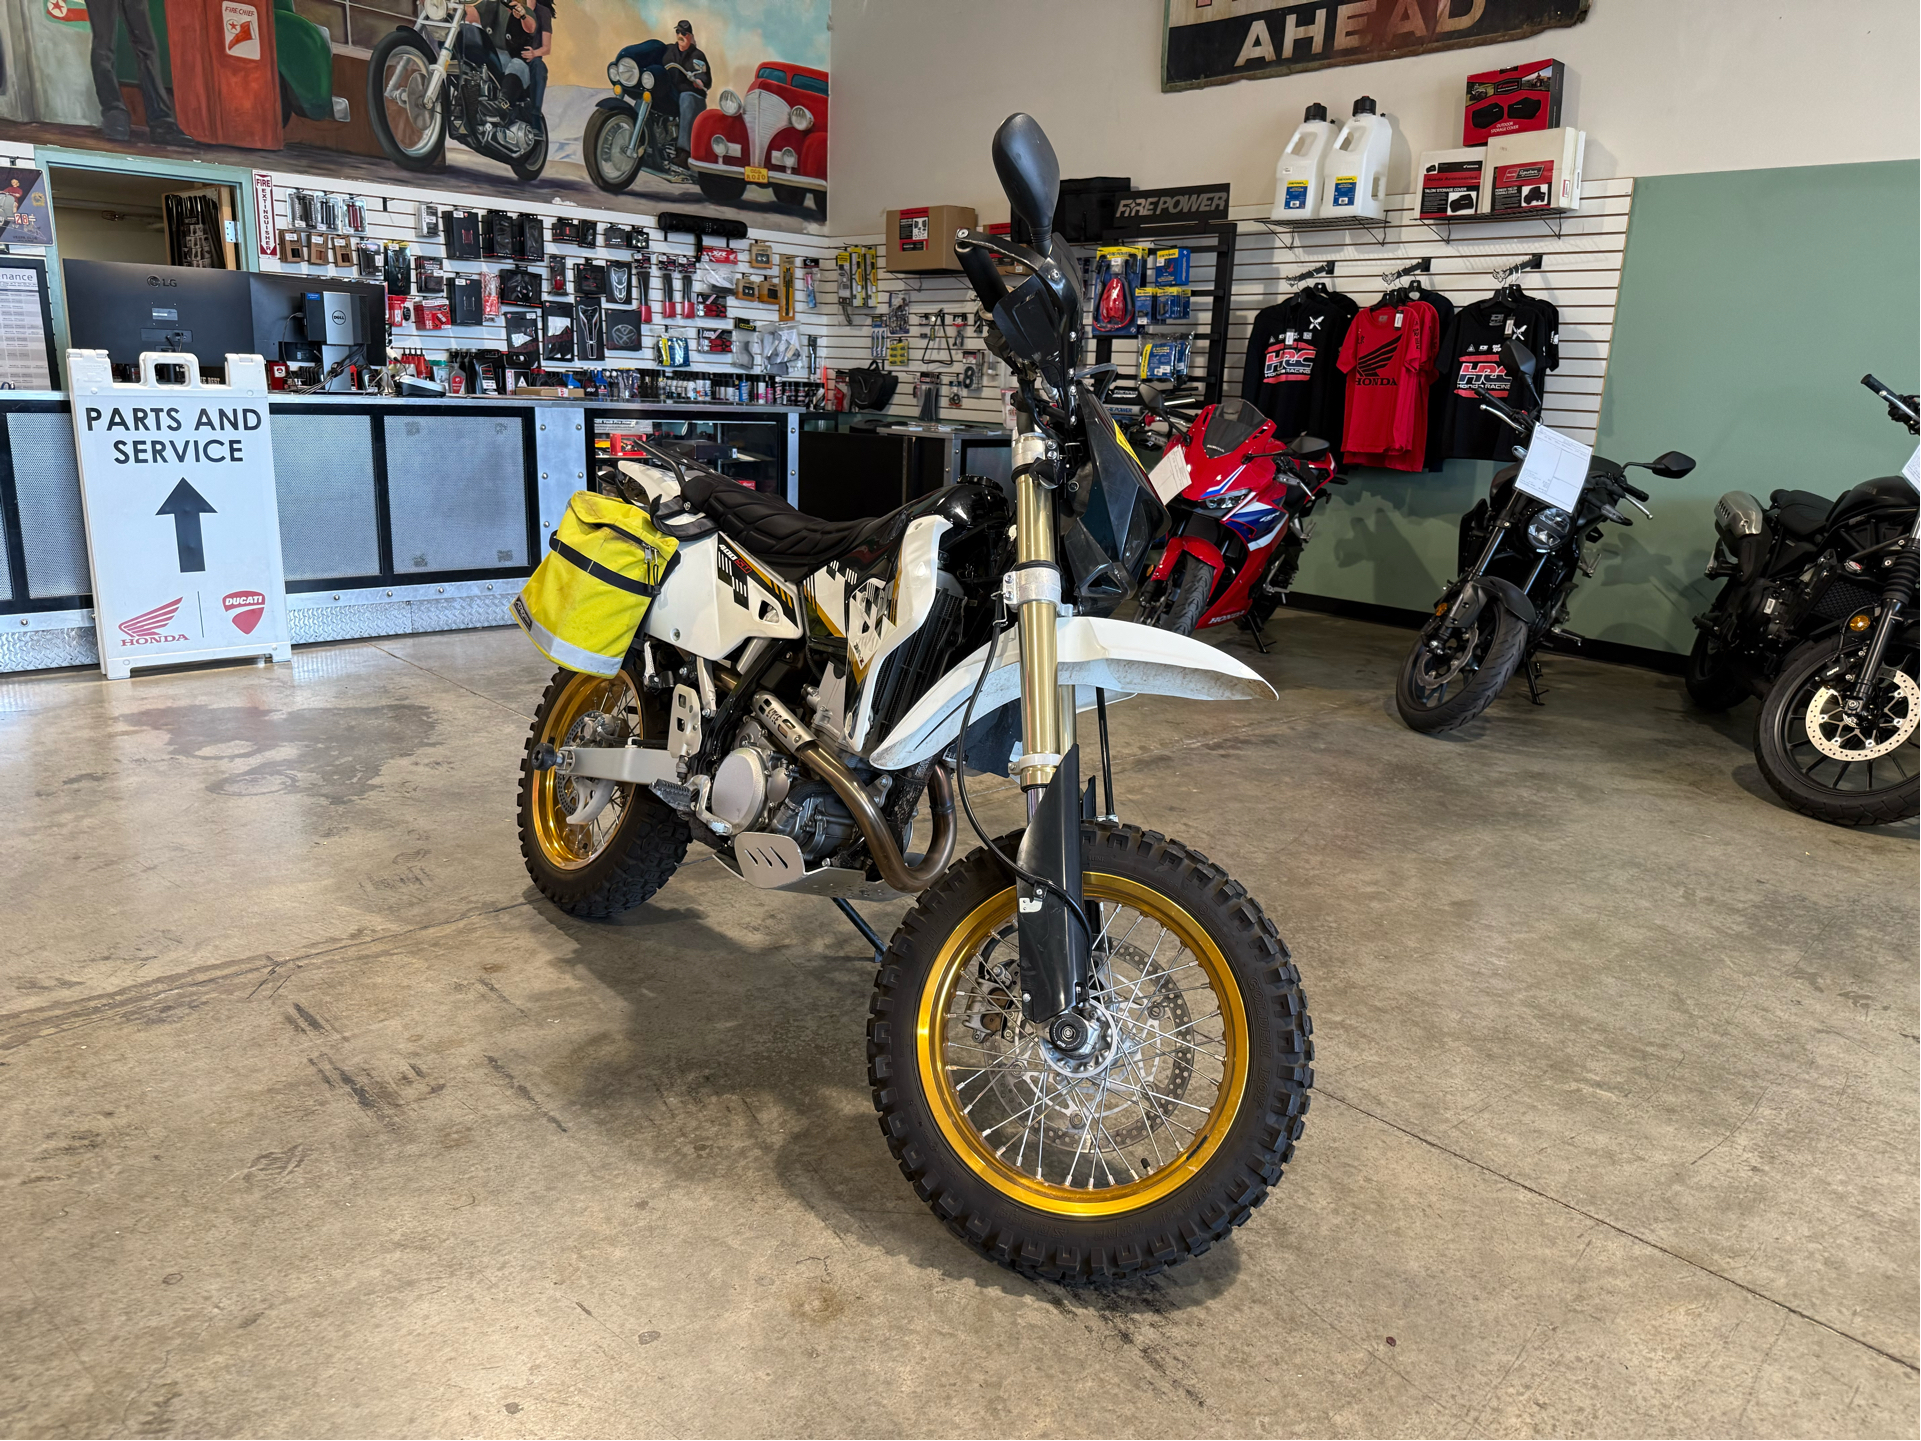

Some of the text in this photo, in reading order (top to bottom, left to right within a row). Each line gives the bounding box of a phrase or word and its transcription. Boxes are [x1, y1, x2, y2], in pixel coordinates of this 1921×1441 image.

[225, 6, 255, 17] FIRE CHIEF
[1234, 0, 1485, 67] AHEAD
[256, 178, 271, 188] FIRE
[1155, 192, 1228, 215] POWER
[261, 188, 271, 251] EXTINGUISHER
[0, 272, 33, 281] nance
[162, 278, 177, 287] LG
[1264, 350, 1316, 373] HRC
[85, 406, 262, 432] PARTS AND
[113, 439, 244, 465] SERVICE
[718, 544, 738, 561] 400
[225, 595, 263, 606] DUCATI
[1208, 610, 1246, 625] HONDA
[120, 633, 190, 647] HONDA
[1248, 975, 1272, 1110] GOLDEN BOY
